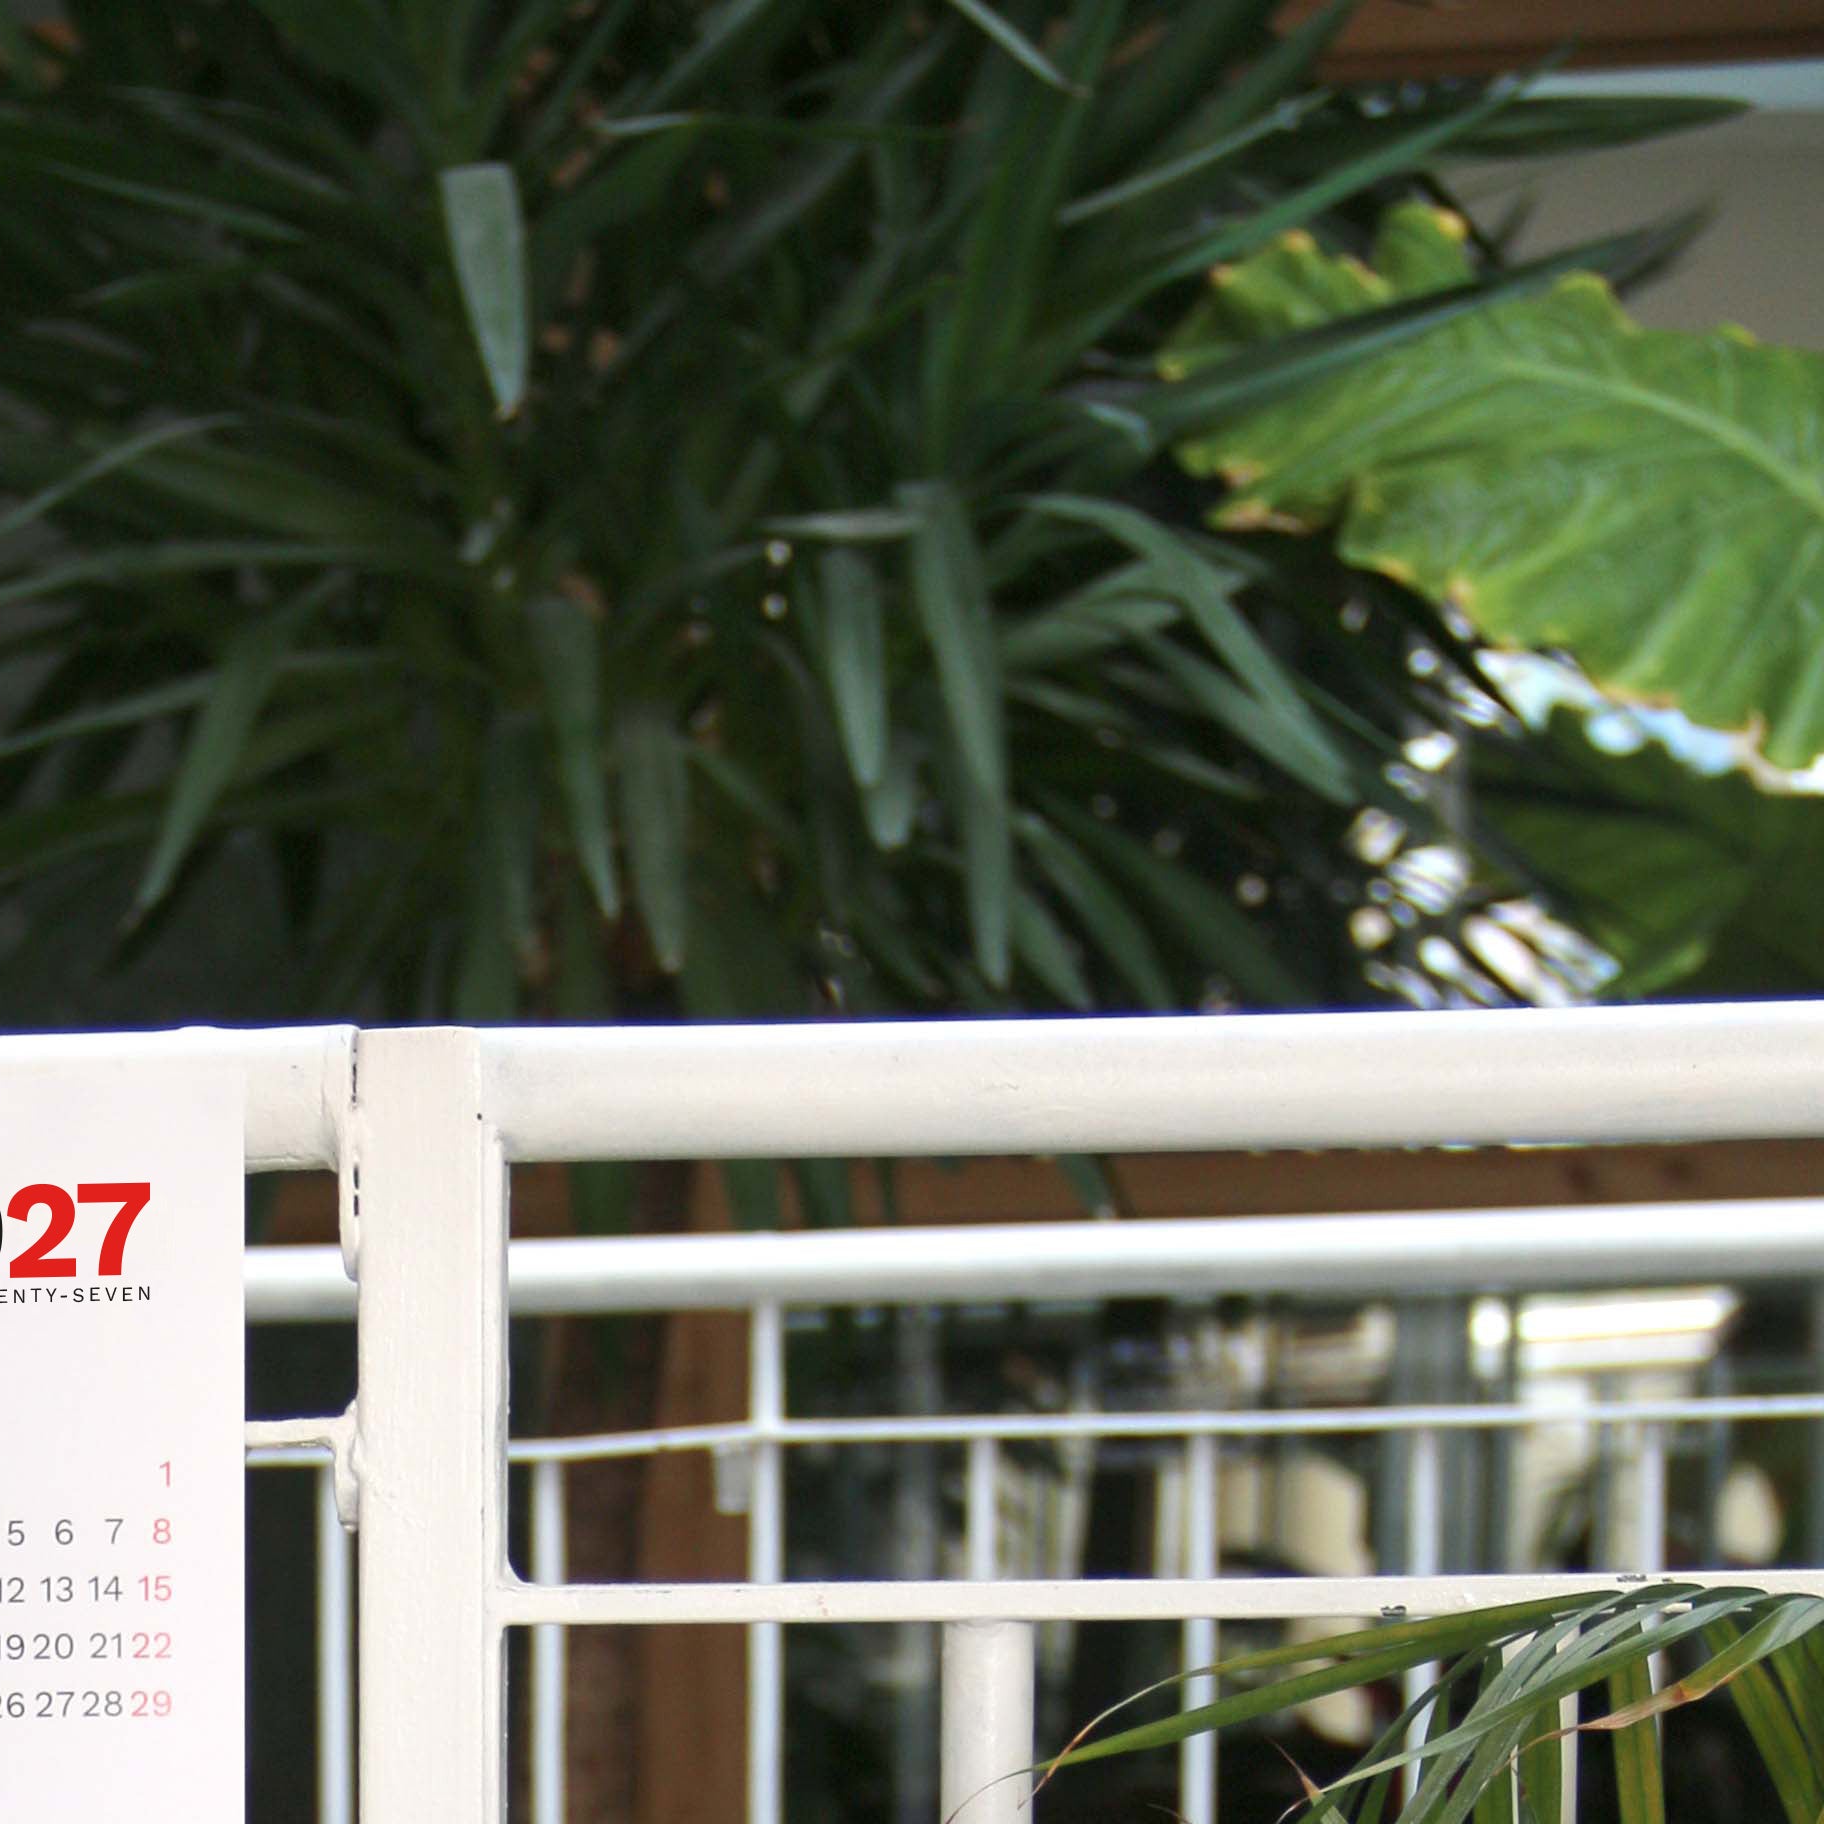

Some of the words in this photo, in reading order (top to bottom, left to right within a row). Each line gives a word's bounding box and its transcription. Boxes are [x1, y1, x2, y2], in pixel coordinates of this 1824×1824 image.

[160, 1461, 171, 1488] 1
[8, 1520, 25, 1546] 5
[55, 1519, 73, 1545] 6
[104, 1518, 123, 1544] 7
[153, 1518, 171, 1544] 8
[40, 1576, 73, 1602] 13
[88, 1576, 123, 1601] 14
[138, 1575, 172, 1601] 15
